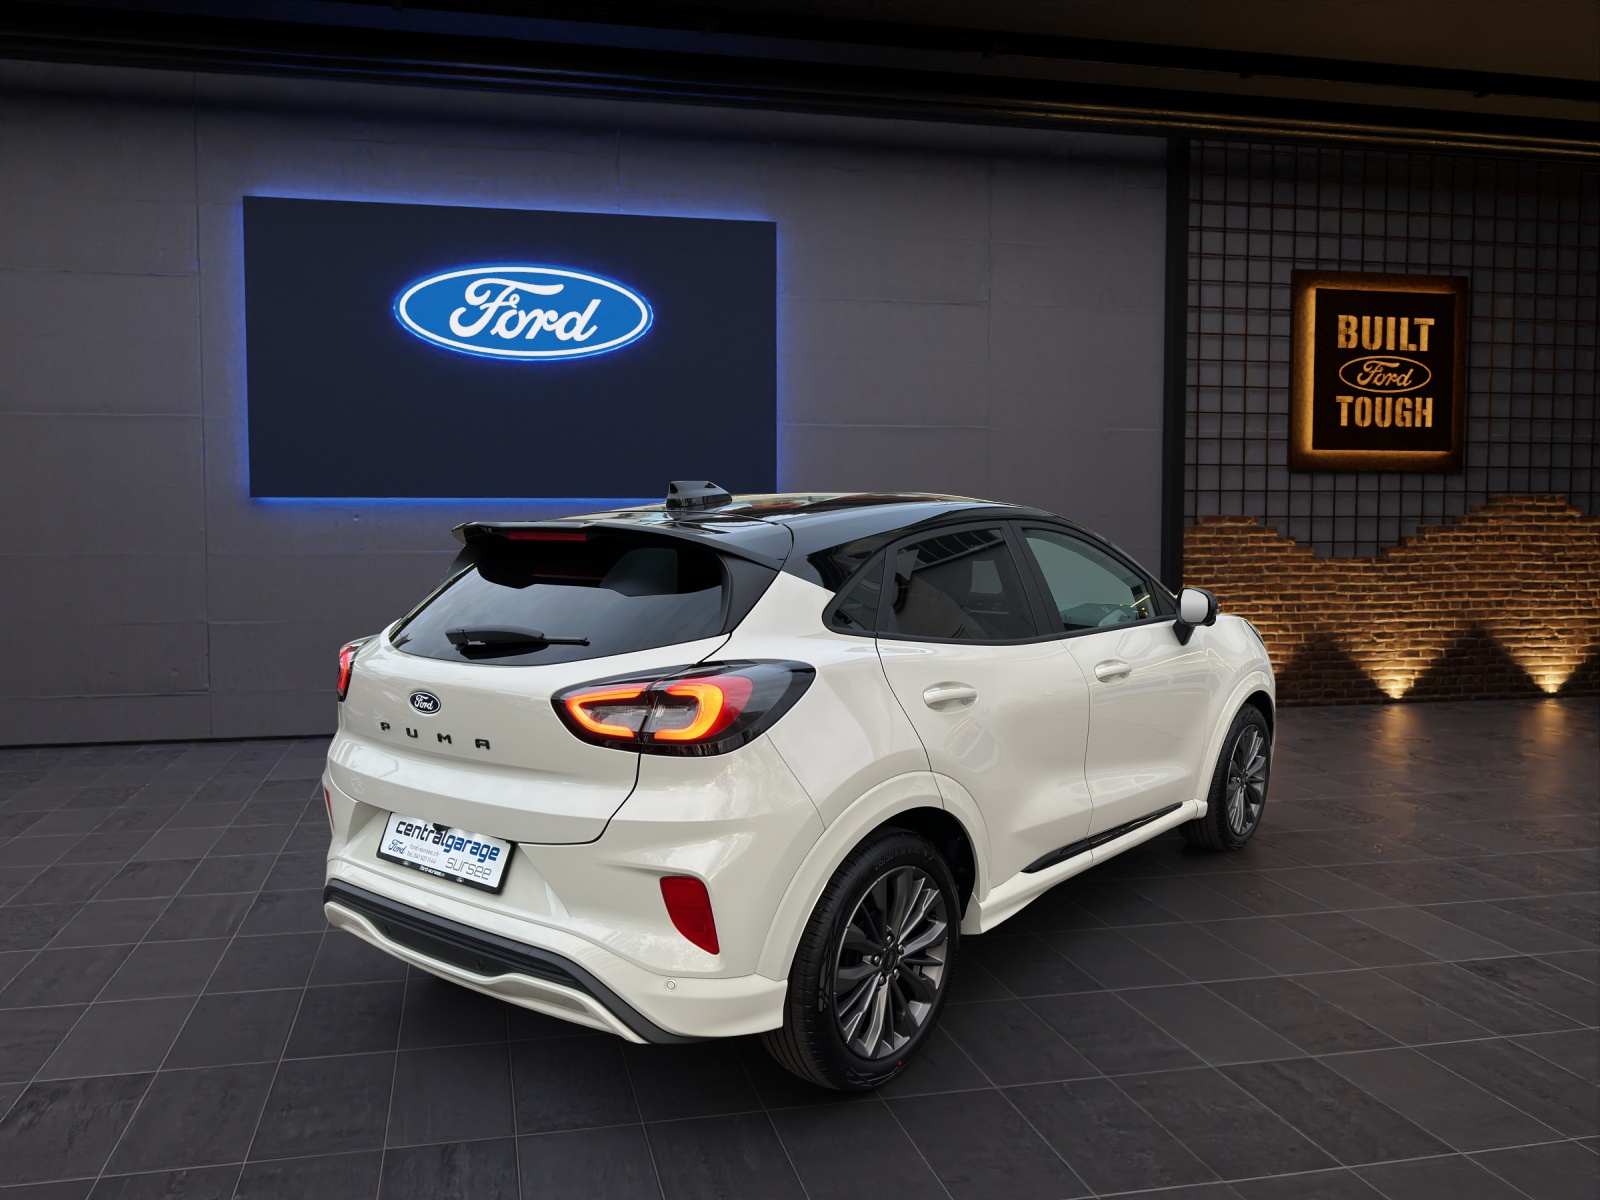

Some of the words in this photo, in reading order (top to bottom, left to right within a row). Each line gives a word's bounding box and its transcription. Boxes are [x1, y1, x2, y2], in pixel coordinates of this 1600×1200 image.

[449, 278, 602, 342] Ford
[1337, 314, 1435, 352] BUILT
[1356, 360, 1414, 387] Ford
[1335, 395, 1433, 428] TOUGH
[414, 694, 434, 710] Ford
[380, 721, 491, 750] PUMA
[387, 838, 407, 855] Ford
[445, 857, 492, 880] sursee
